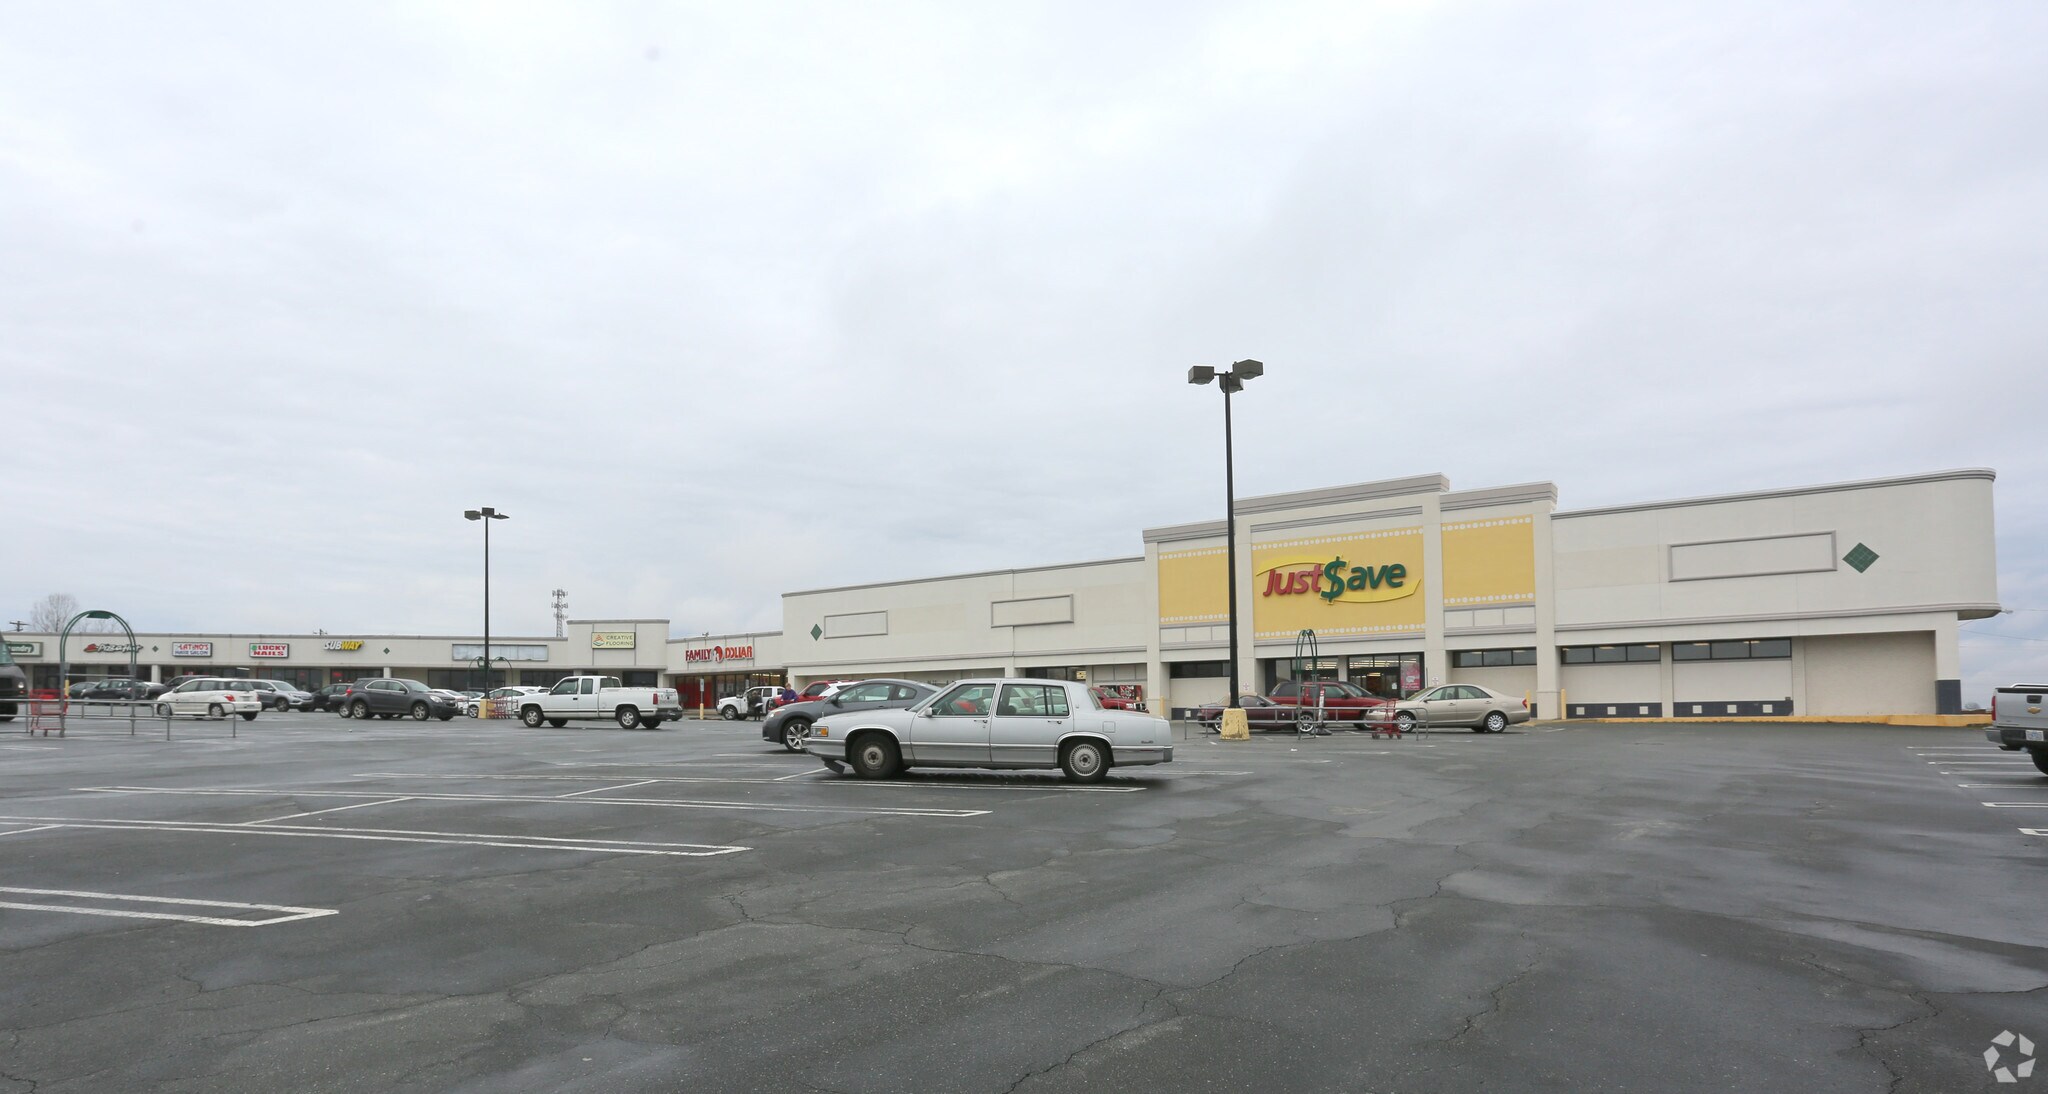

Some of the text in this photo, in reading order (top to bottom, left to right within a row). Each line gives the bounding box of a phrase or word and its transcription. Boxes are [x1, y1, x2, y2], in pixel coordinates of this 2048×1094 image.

[1263, 563, 1323, 597] Just
[324, 640, 365, 650] SUBWAY
[685, 645, 753, 662] FAMILY DOLLAR
